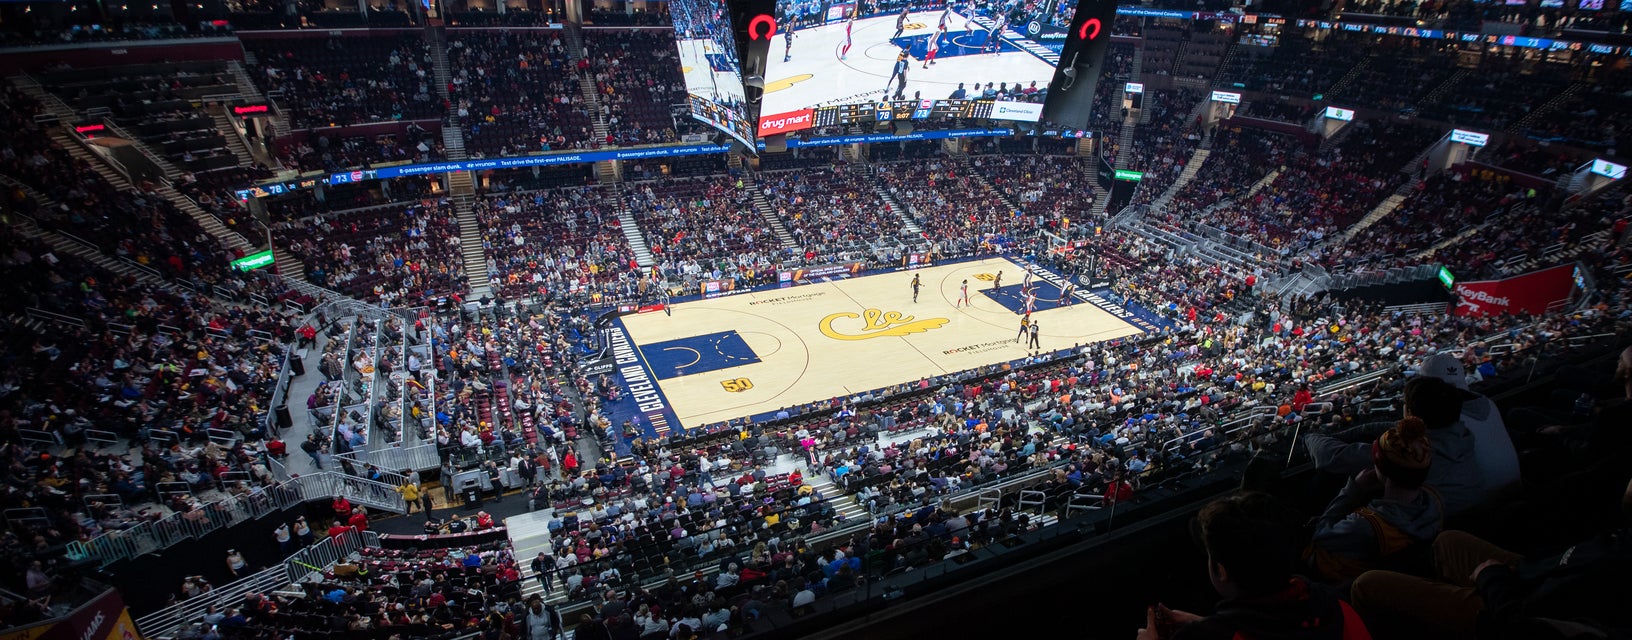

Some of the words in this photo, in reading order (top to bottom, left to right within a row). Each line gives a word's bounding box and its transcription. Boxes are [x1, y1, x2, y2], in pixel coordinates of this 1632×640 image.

[1527, 38, 1539, 47] 73
[761, 119, 784, 129] drug
[786, 112, 810, 126] mart
[879, 112, 890, 120] 78
[336, 174, 348, 183] 73
[269, 185, 283, 194] 78
[748, 297, 786, 306] ROCKET
[787, 292, 826, 300] Mortgage
[1456, 284, 1510, 306] KeyBank
[942, 344, 980, 356] ROCKET
[620, 364, 665, 412] CLEVELAND
[720, 377, 754, 393] 50
